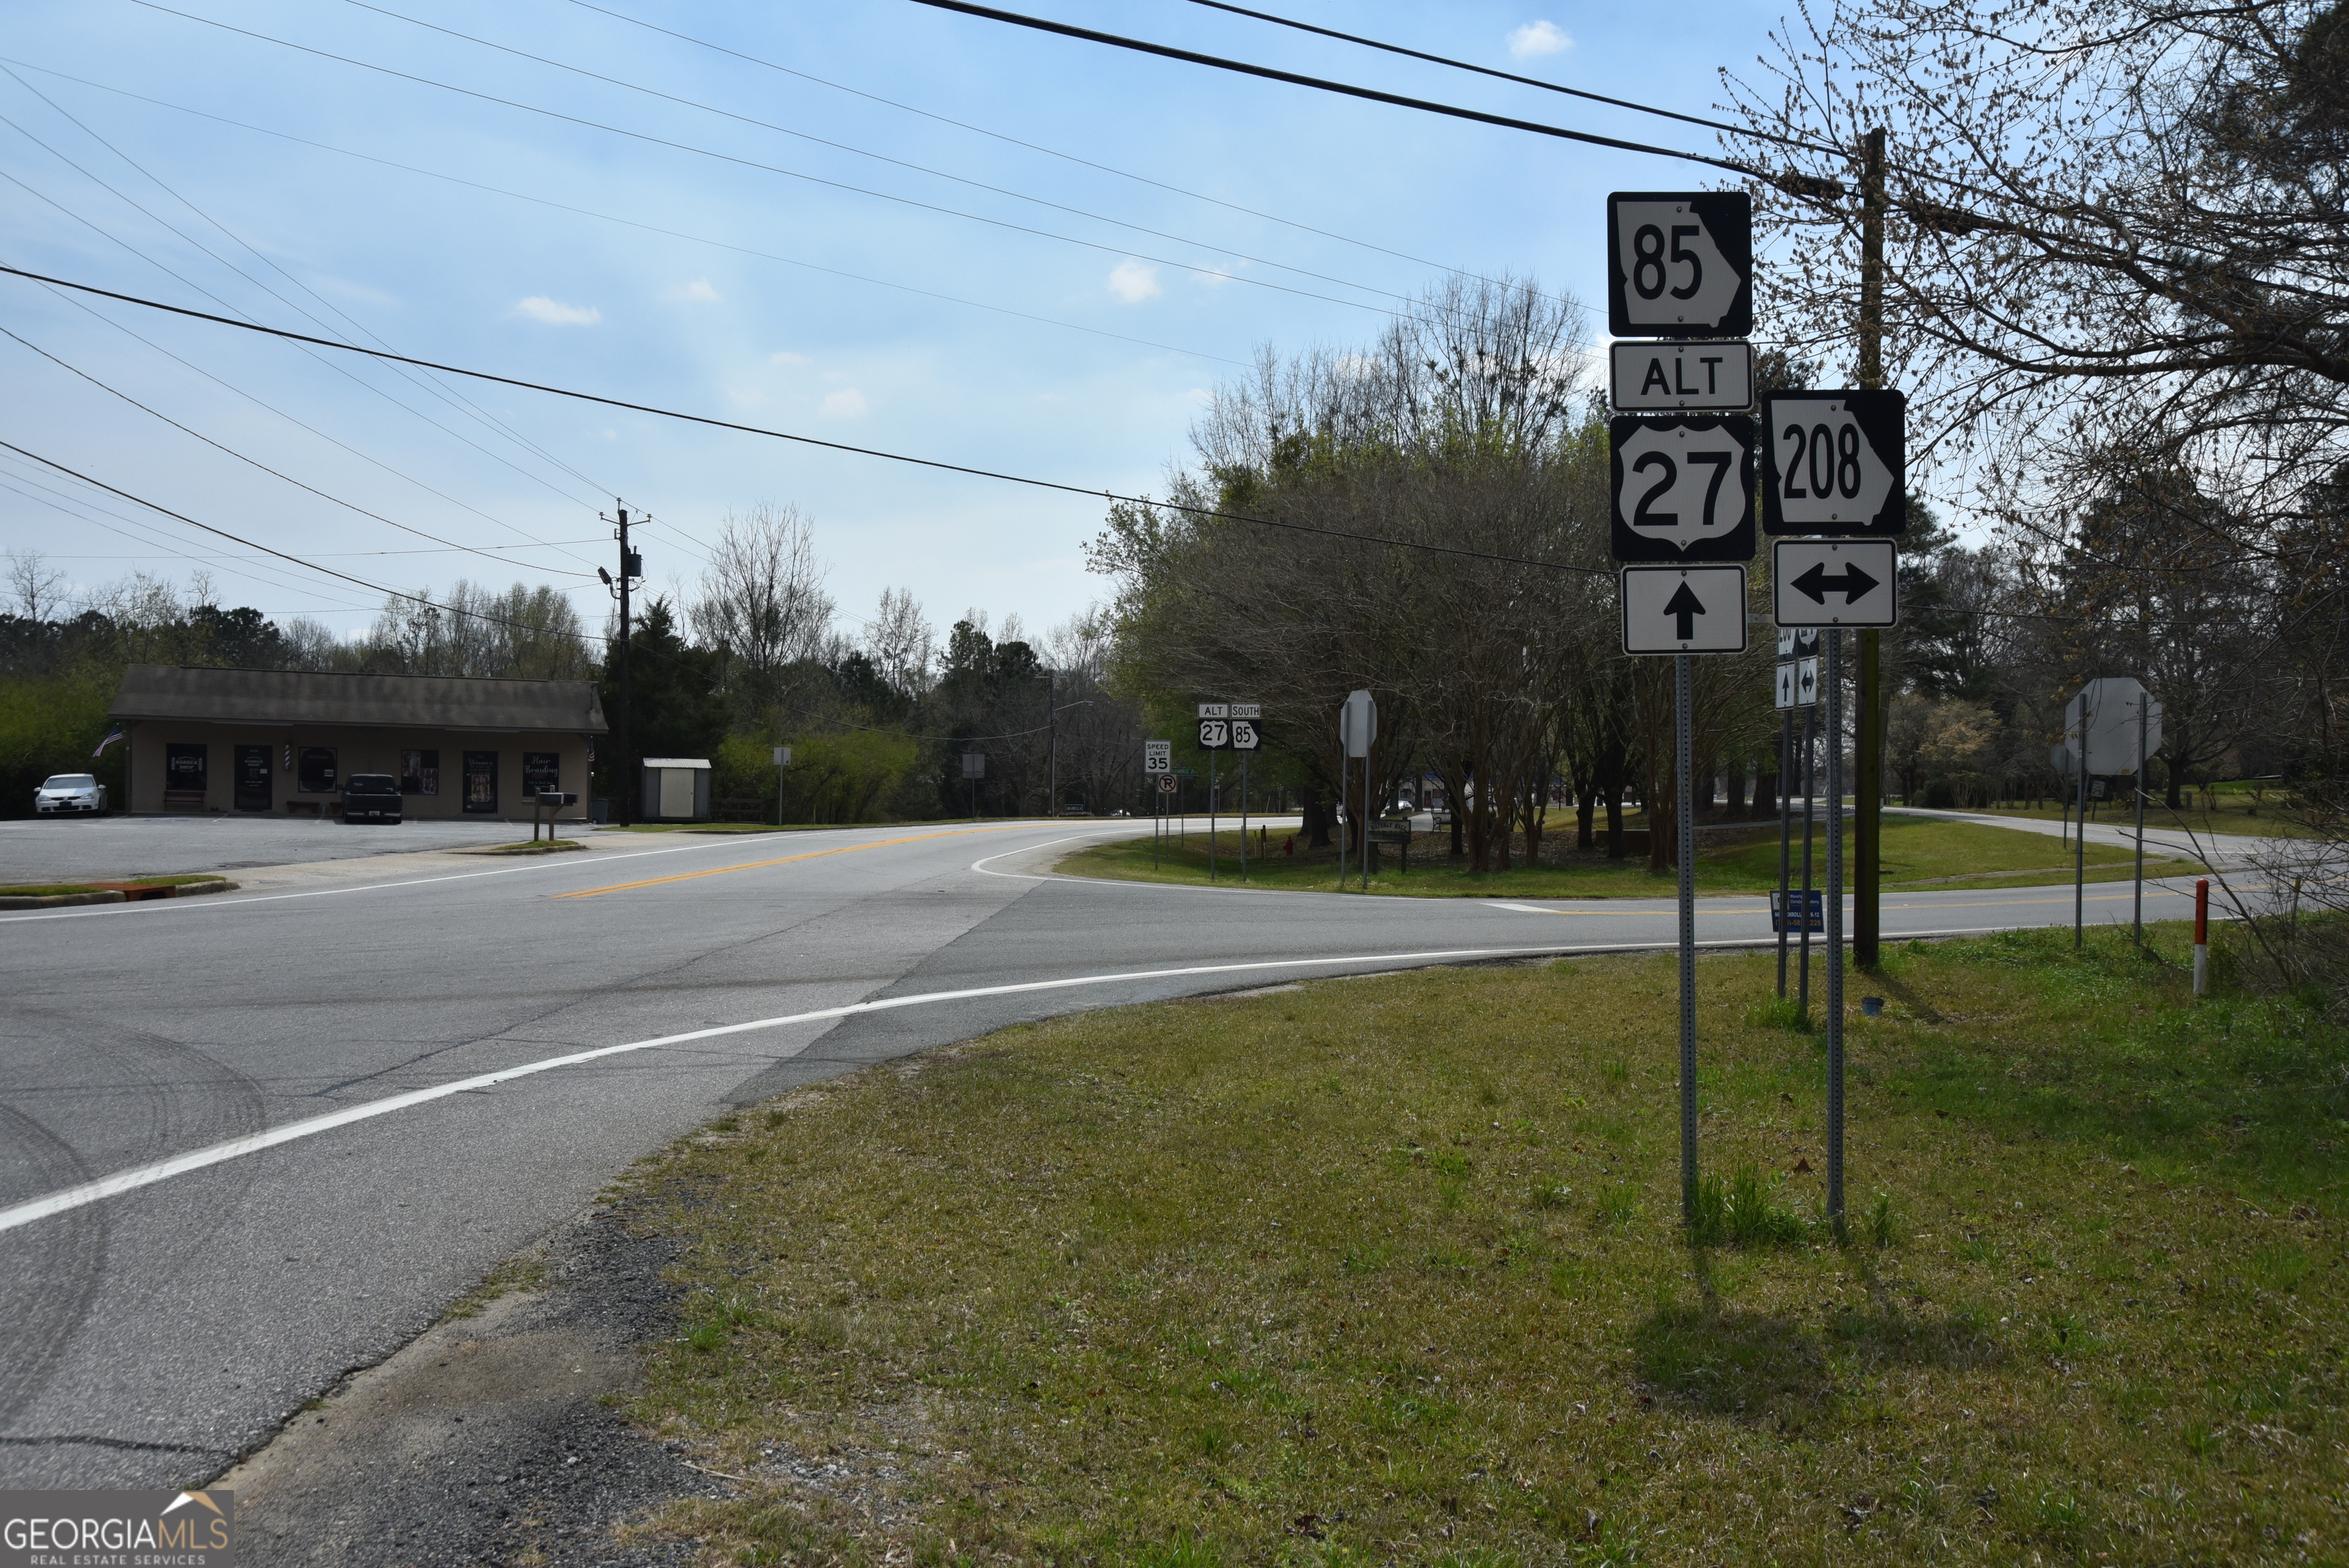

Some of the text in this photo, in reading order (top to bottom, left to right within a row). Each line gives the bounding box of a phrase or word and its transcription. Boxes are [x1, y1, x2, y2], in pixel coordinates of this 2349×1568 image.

[1633, 223, 1702, 300] 85
[1641, 357, 1723, 396] ALT
[1783, 423, 1861, 499] 208
[1633, 451, 1733, 526] 27
[1204, 706, 1223, 716] ALT
[1233, 706, 1259, 716] SOUTH
[1202, 724, 1224, 741] 27
[1235, 726, 1251, 743] 85
[531, 755, 551, 765] Hair
[1148, 758, 1168, 769] 35
[525, 765, 558, 778] Braiding
[1371, 822, 1392, 830] WAVERLY
